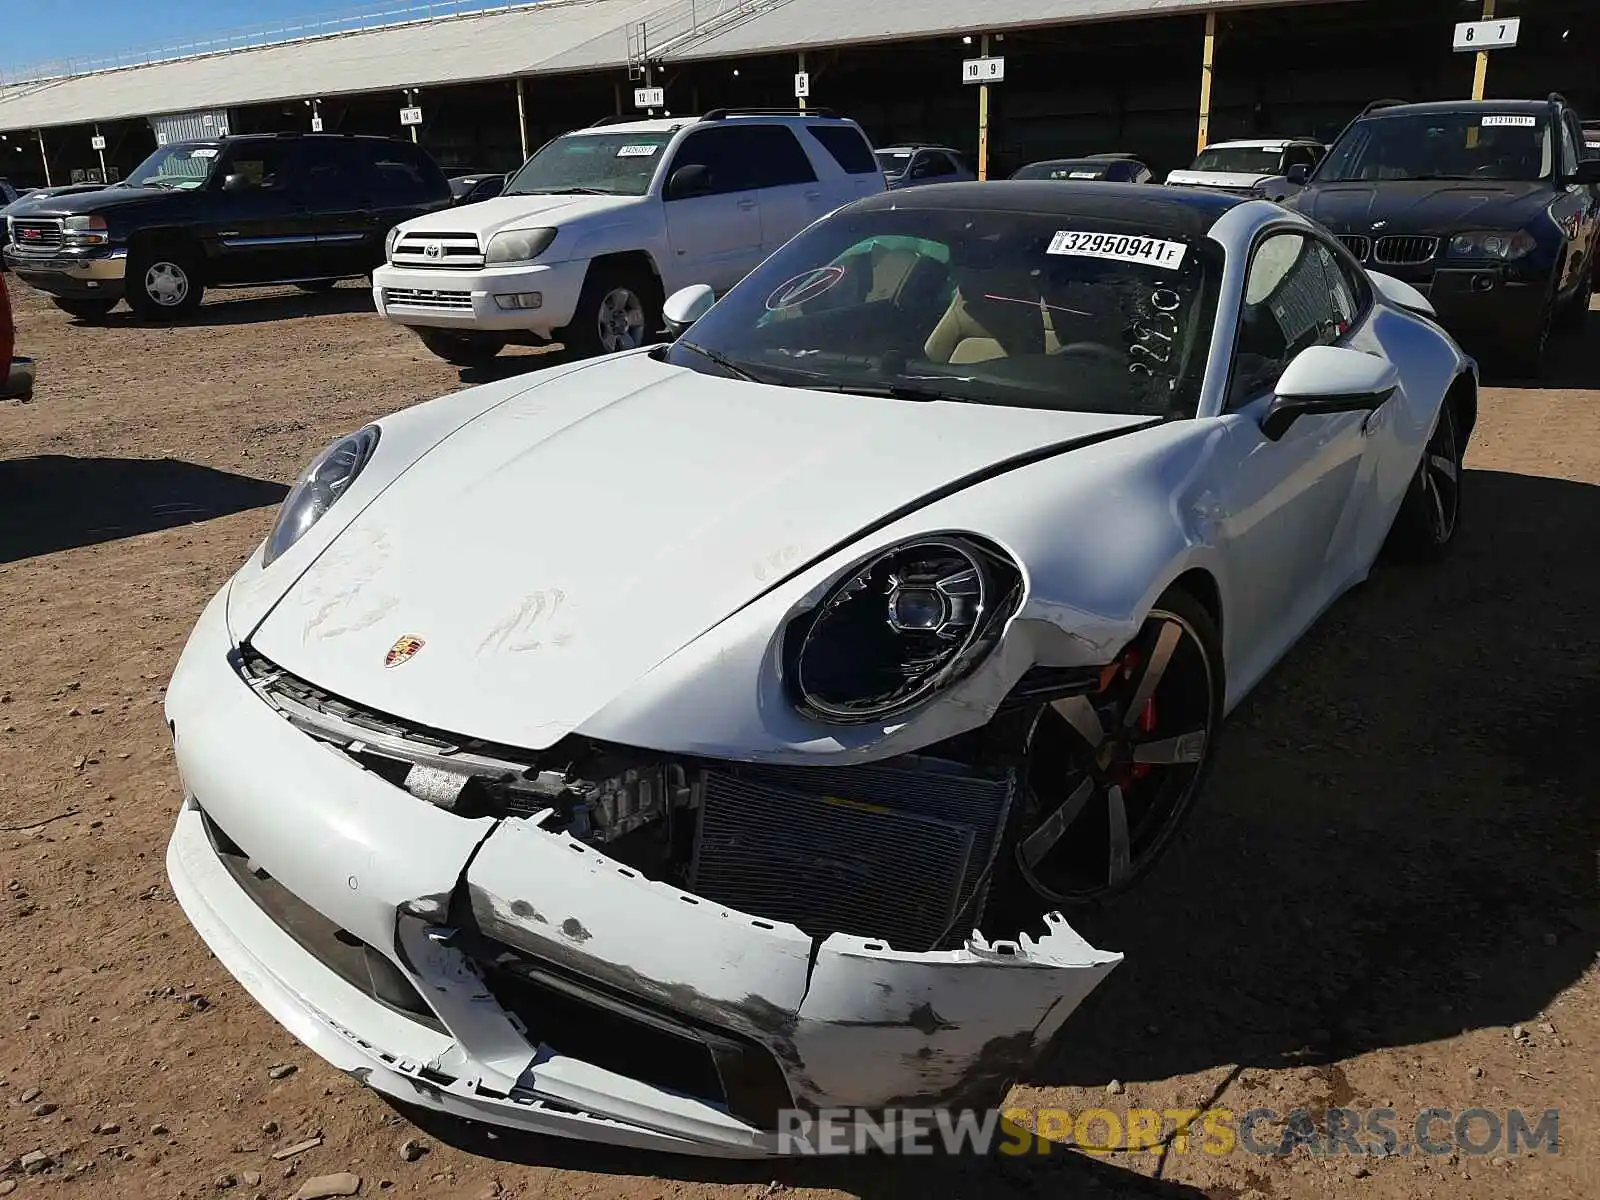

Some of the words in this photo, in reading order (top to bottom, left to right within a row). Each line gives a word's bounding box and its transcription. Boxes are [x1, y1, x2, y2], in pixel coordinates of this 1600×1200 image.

[1465, 26, 1475, 42] 8
[1497, 25, 1506, 39] 7
[969, 64, 978, 76] 10
[990, 63, 997, 75] 9
[799, 76, 806, 89] G
[638, 93, 647, 103] 12
[653, 92, 660, 102] 11
[1065, 233, 1166, 261] 32950941
[1166, 250, 1176, 261] F
